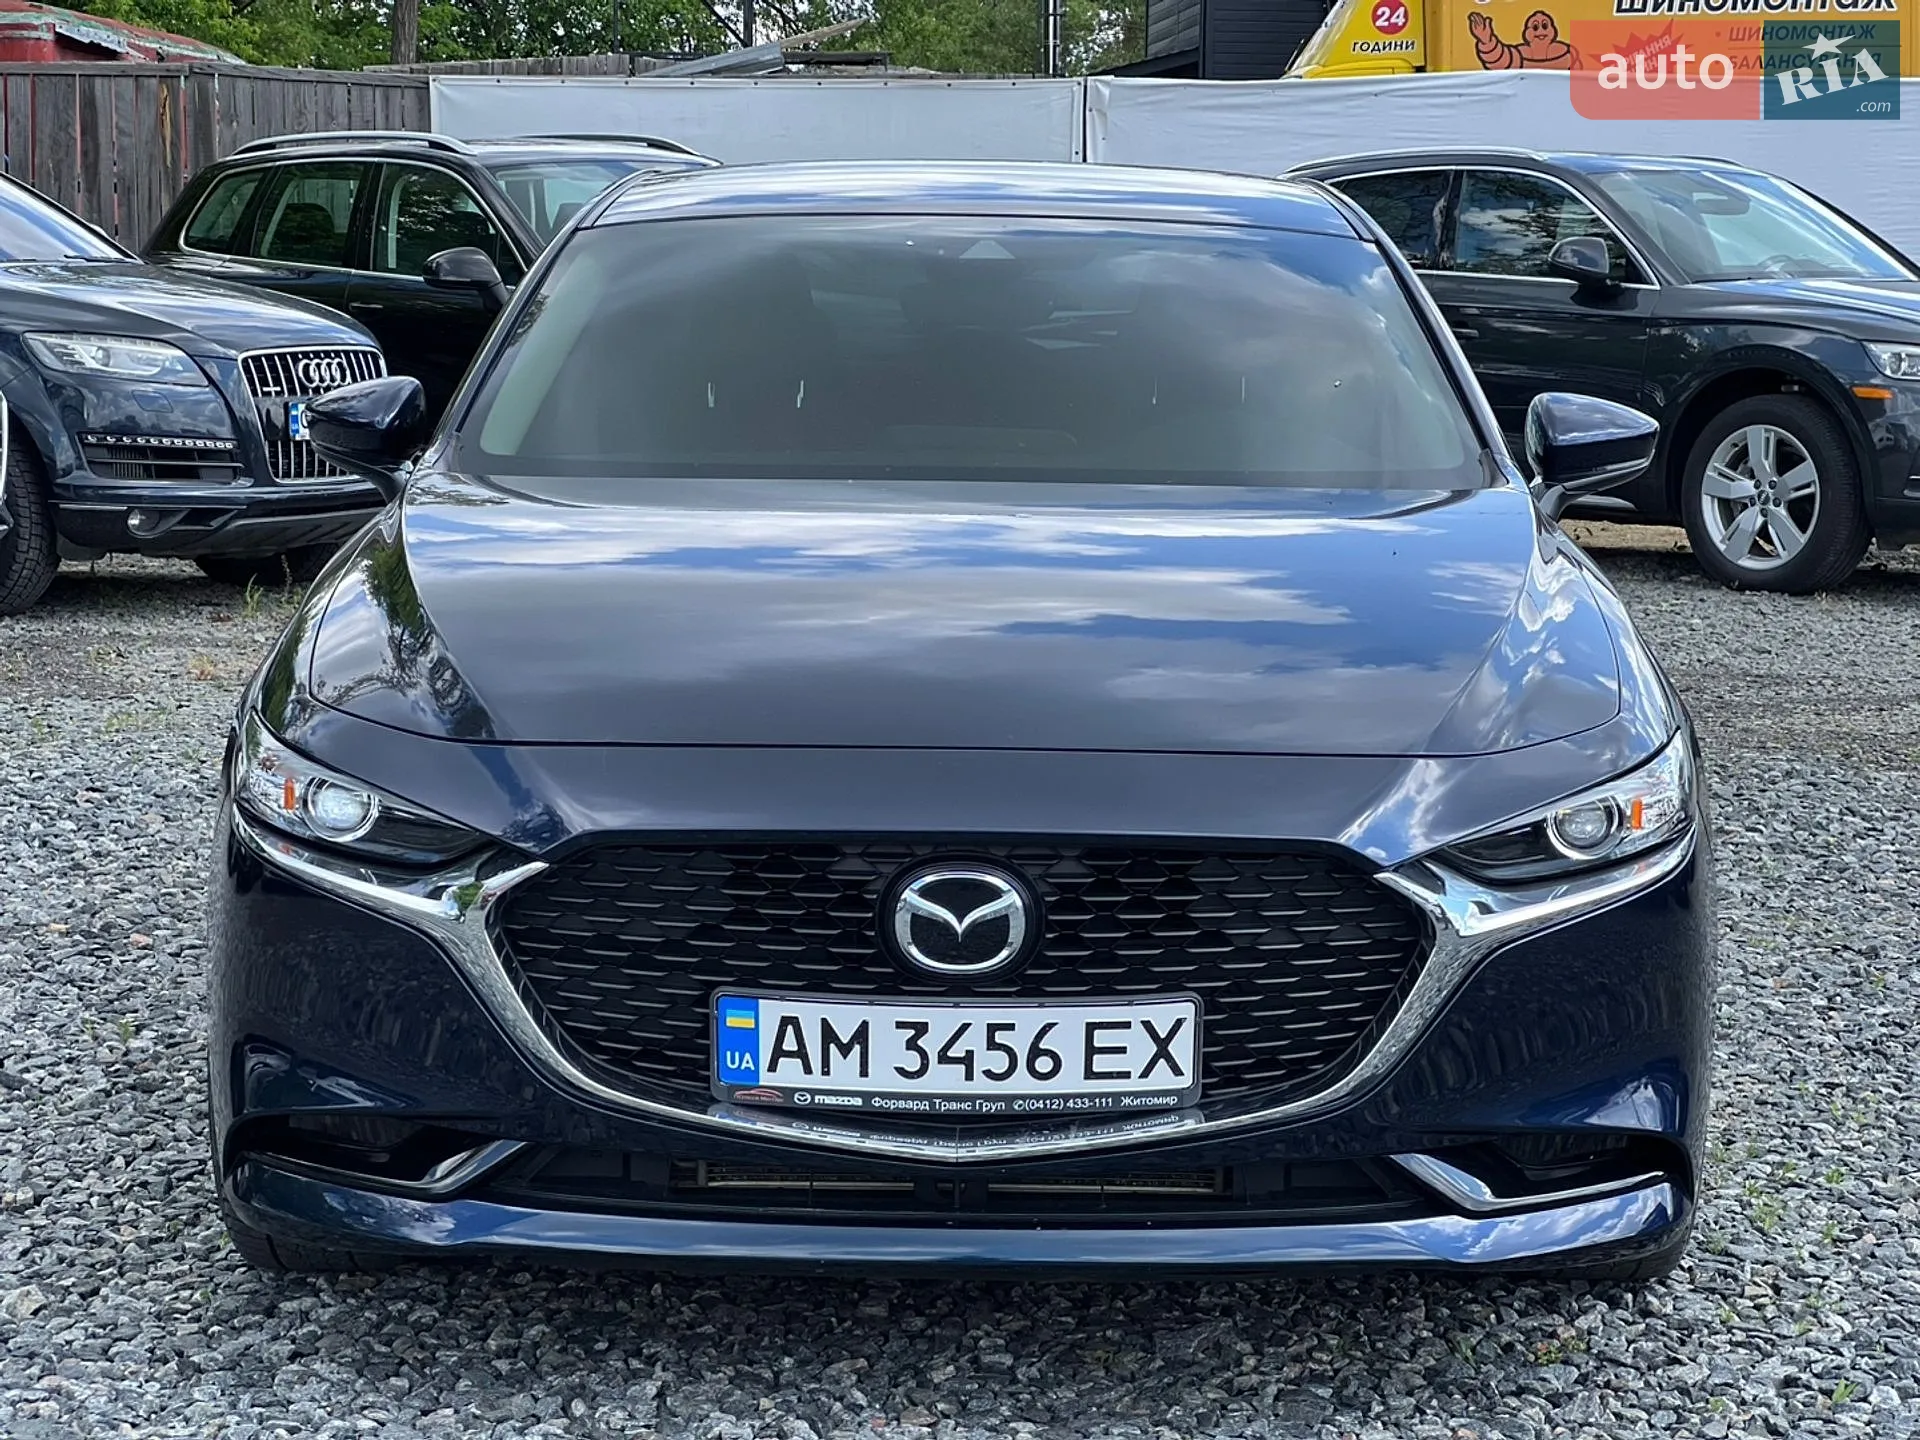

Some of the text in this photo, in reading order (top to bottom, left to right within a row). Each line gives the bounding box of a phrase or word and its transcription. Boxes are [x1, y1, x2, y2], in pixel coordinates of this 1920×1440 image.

[1375, 6, 1406, 27] 24
[1728, 24, 1878, 41] ШИНОМОНТАЖ
[1352, 40, 1416, 54] ГОДИНИ
[1729, 52, 1882, 70] БАЛАНСУВАНЯ
[767, 1016, 1188, 1082] AM 3456 EX
[726, 1051, 755, 1070] UA
[814, 1095, 863, 1106] mazda
[871, 1096, 1178, 1113] Форвард Транс Груп (0412) 433-111 Житомир
